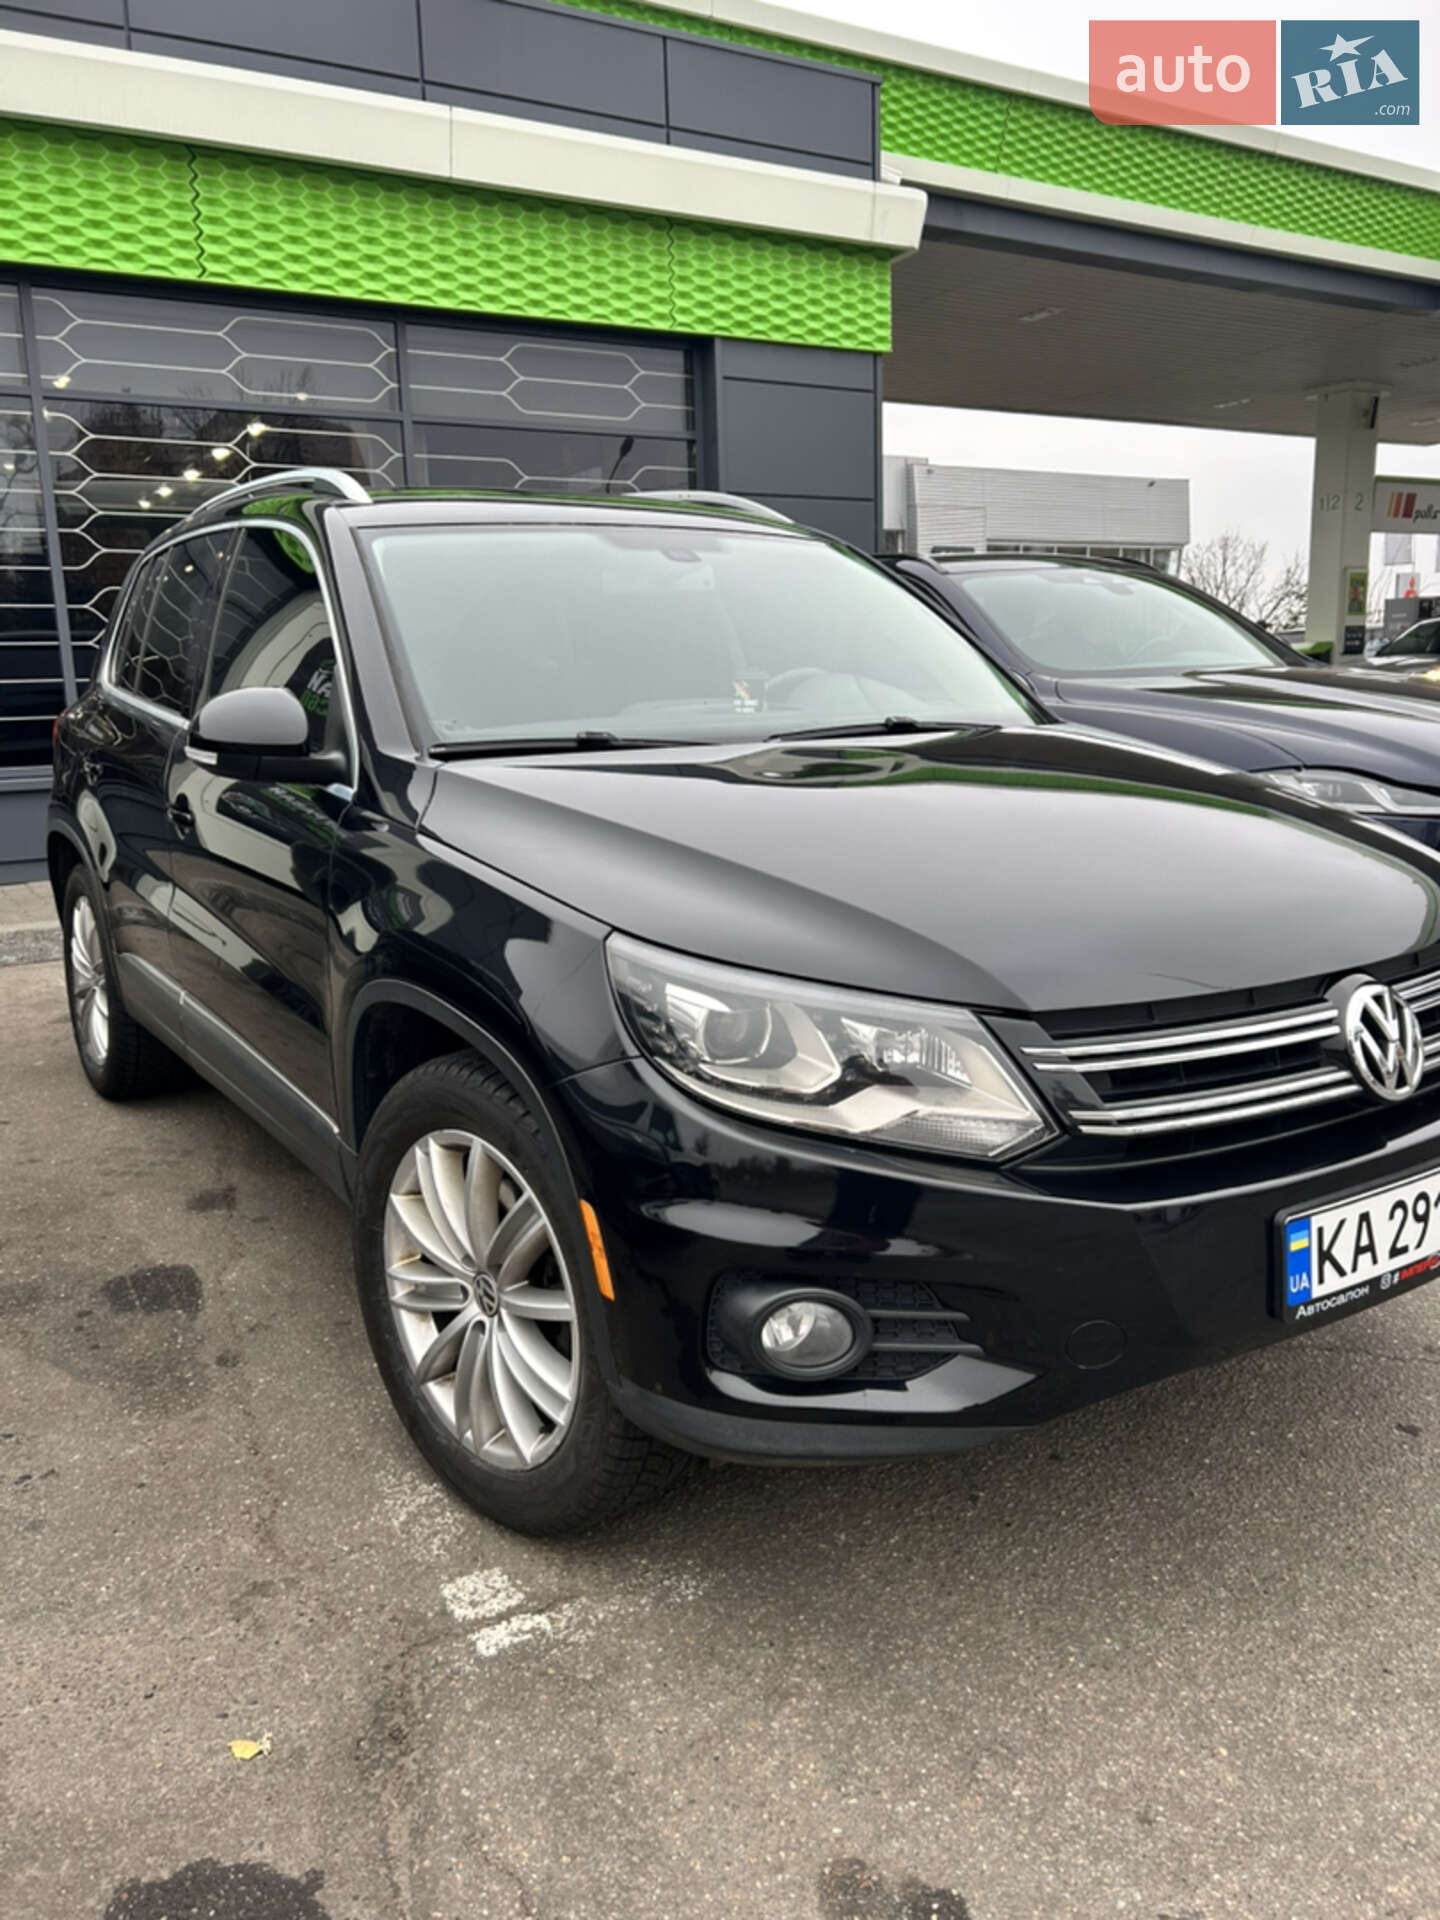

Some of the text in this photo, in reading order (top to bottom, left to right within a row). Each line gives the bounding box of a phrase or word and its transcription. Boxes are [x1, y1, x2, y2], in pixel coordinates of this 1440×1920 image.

[1353, 491, 1364, 511] 2
[1317, 1210, 1378, 1285] KA
[1289, 1271, 1311, 1294] UA
[1295, 1284, 1370, 1321] Автосалон
